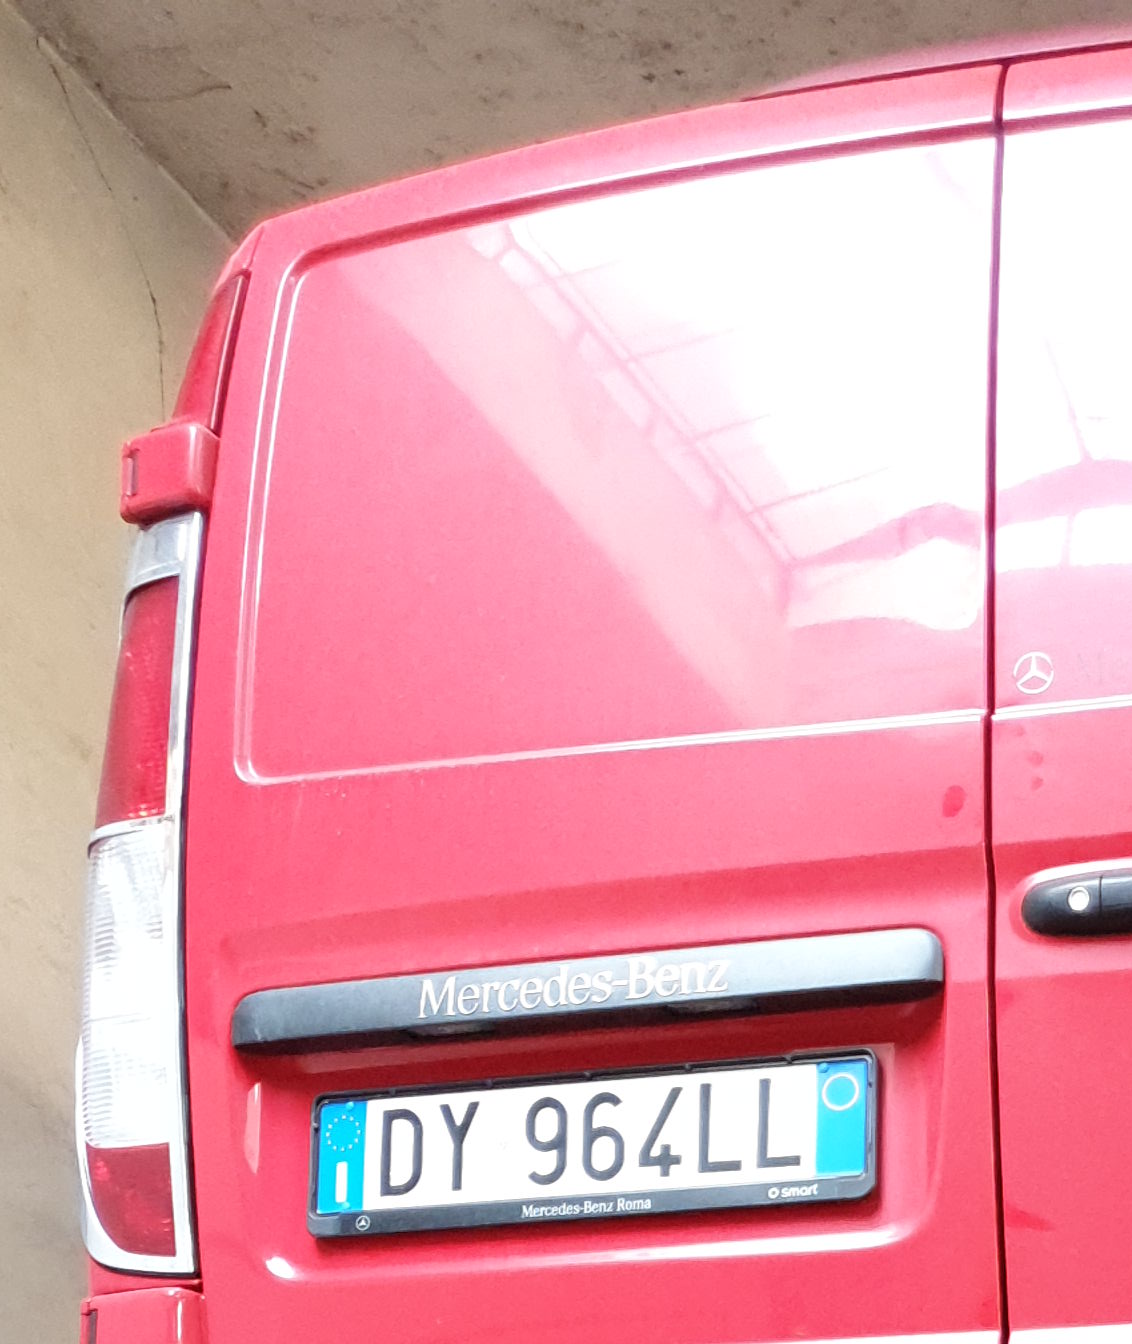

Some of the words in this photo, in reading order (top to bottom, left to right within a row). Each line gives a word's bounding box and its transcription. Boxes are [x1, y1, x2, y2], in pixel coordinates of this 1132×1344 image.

[416, 955, 732, 1019] Mercedes-Benz
[379, 1100, 481, 1198] DY
[524, 1077, 802, 1186] 964LL
[521, 1199, 614, 1219] Mercedes-Benz
[616, 1198, 652, 1212] Roma
[780, 1182, 818, 1198] smart
